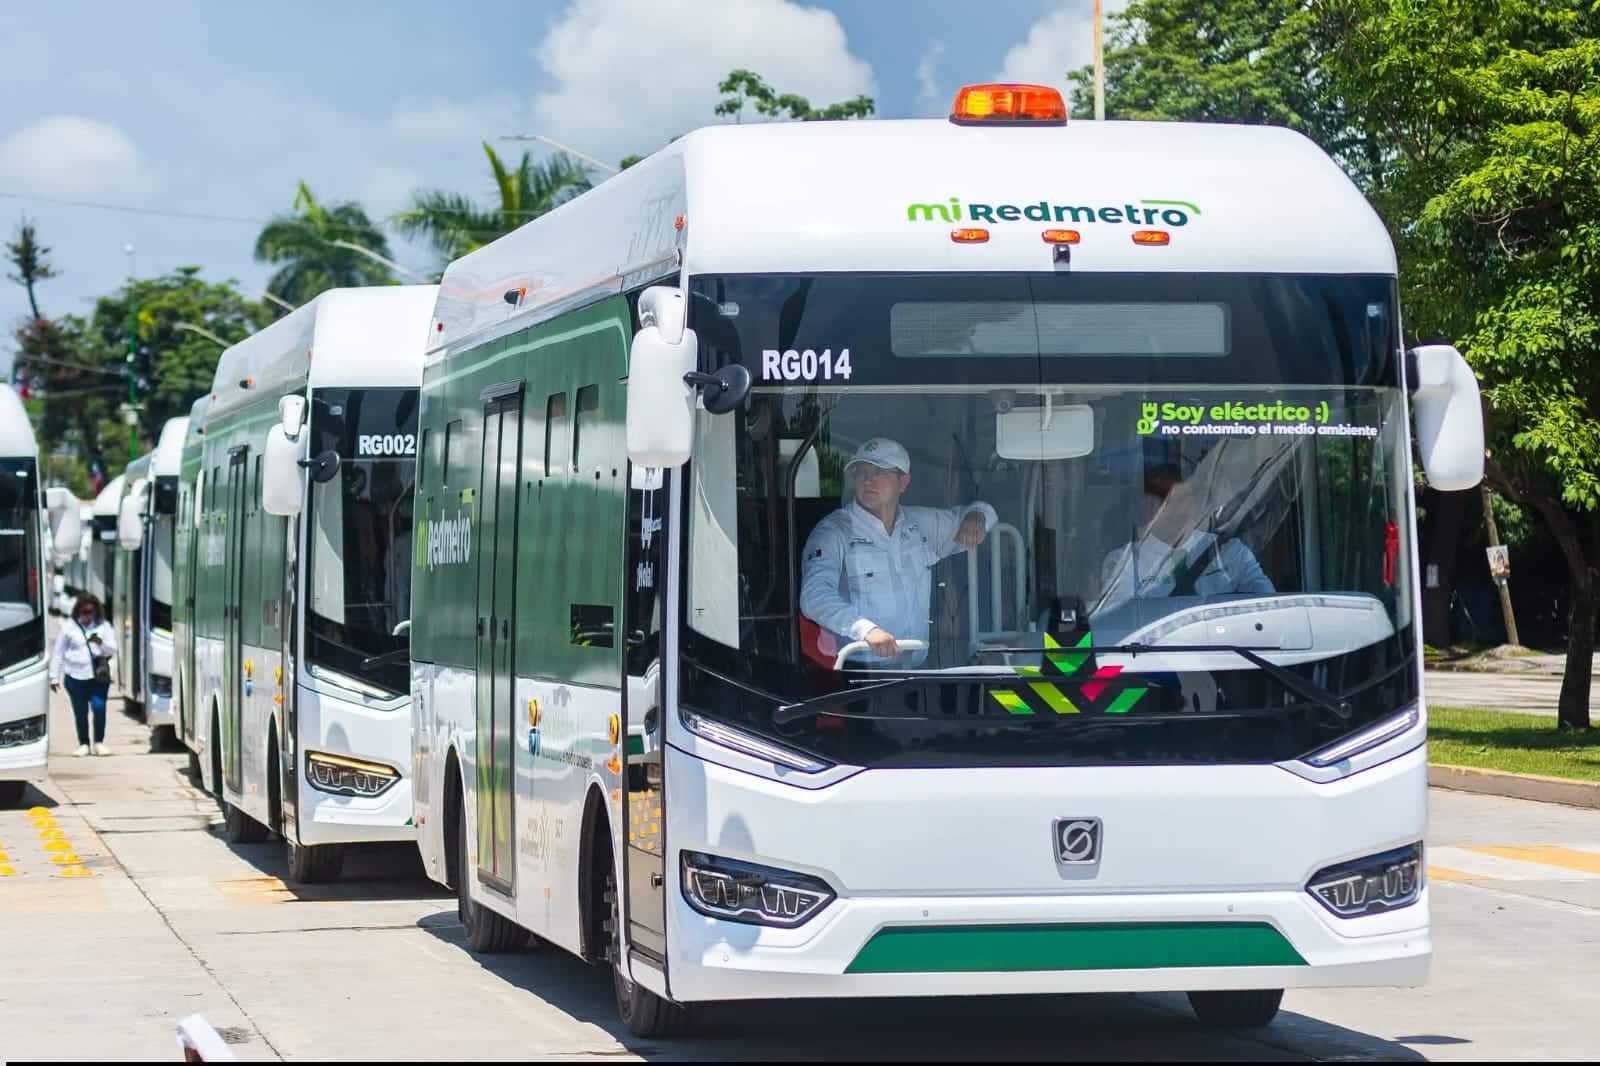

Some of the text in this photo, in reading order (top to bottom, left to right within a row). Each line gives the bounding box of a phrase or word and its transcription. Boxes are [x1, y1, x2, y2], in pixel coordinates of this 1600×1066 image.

[908, 197, 1188, 227] mi Redmetro
[762, 348, 852, 380] RG014
[1161, 402, 1204, 424] Soy
[1209, 400, 1310, 421] eléctrico
[1162, 422, 1378, 436] no contamino el medio ambiente
[359, 434, 416, 455] RG002
